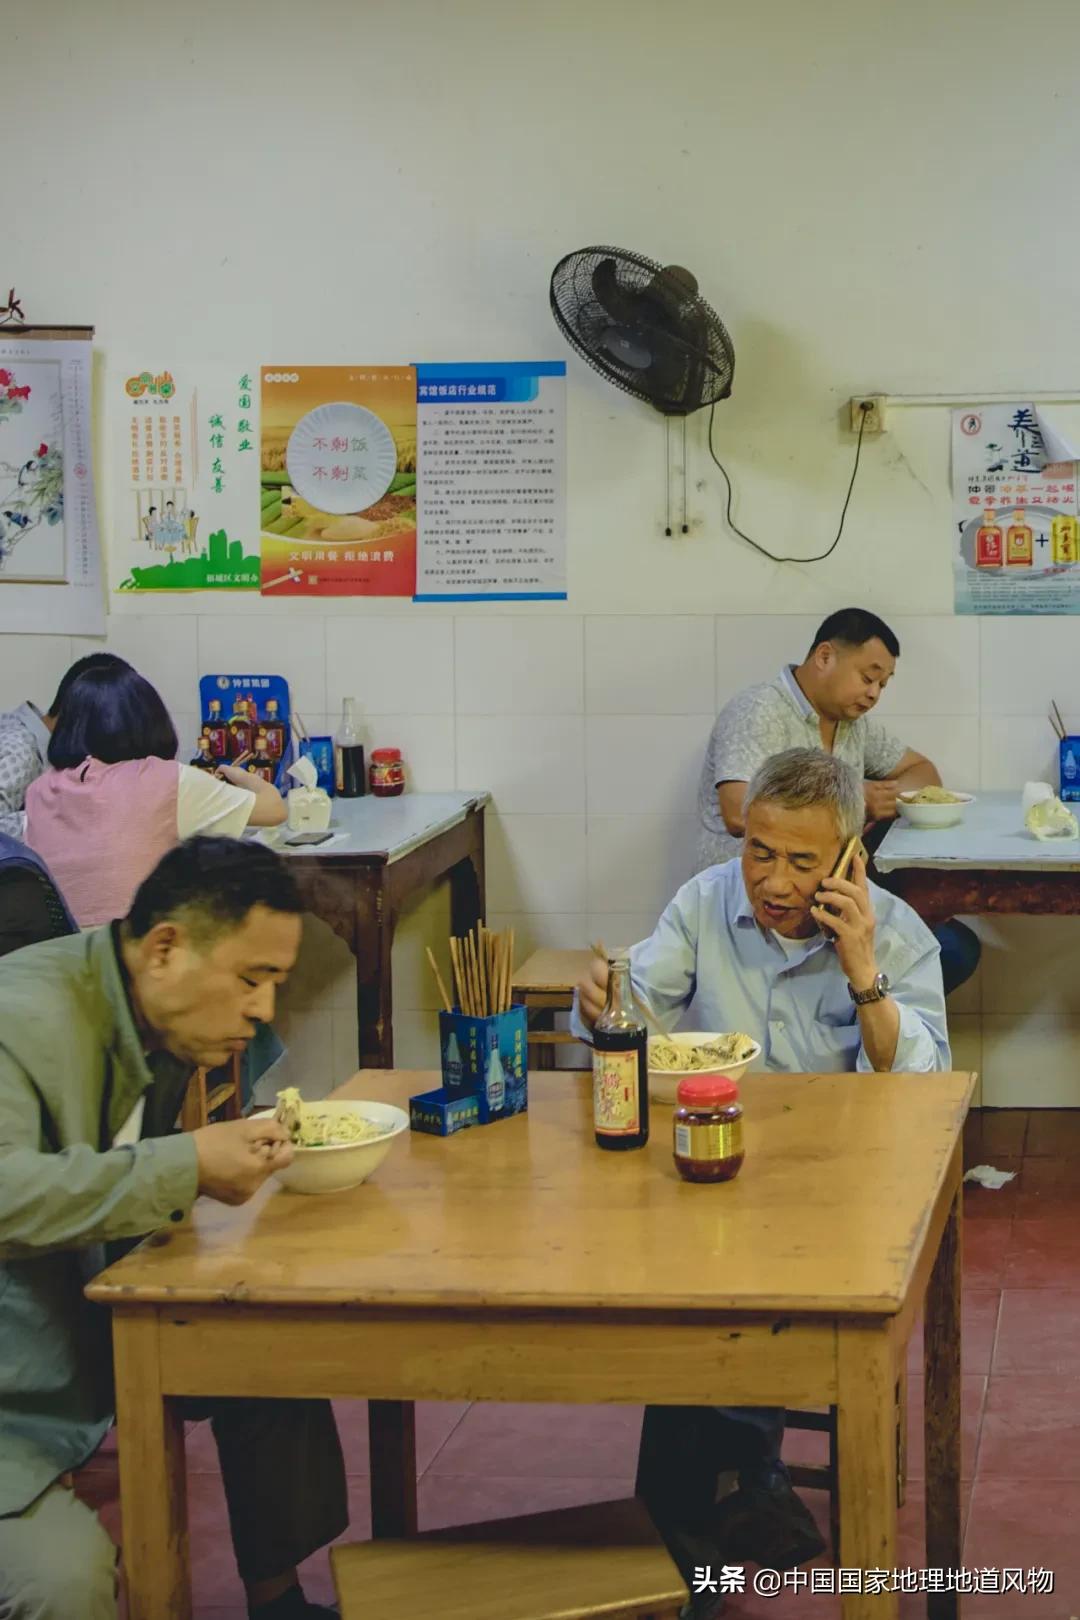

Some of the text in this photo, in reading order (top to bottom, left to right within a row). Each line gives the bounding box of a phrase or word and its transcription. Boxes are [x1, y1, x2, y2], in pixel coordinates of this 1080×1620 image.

[419, 384, 497, 397] 宾馆饭店行业规范
[237, 374, 254, 452] 爱国 敬业
[312, 436, 369, 453] 不剩饭
[208, 414, 226, 494] 诚信 友善
[312, 465, 369, 482] 不剩菜
[289, 551, 338, 562] 文明用餐
